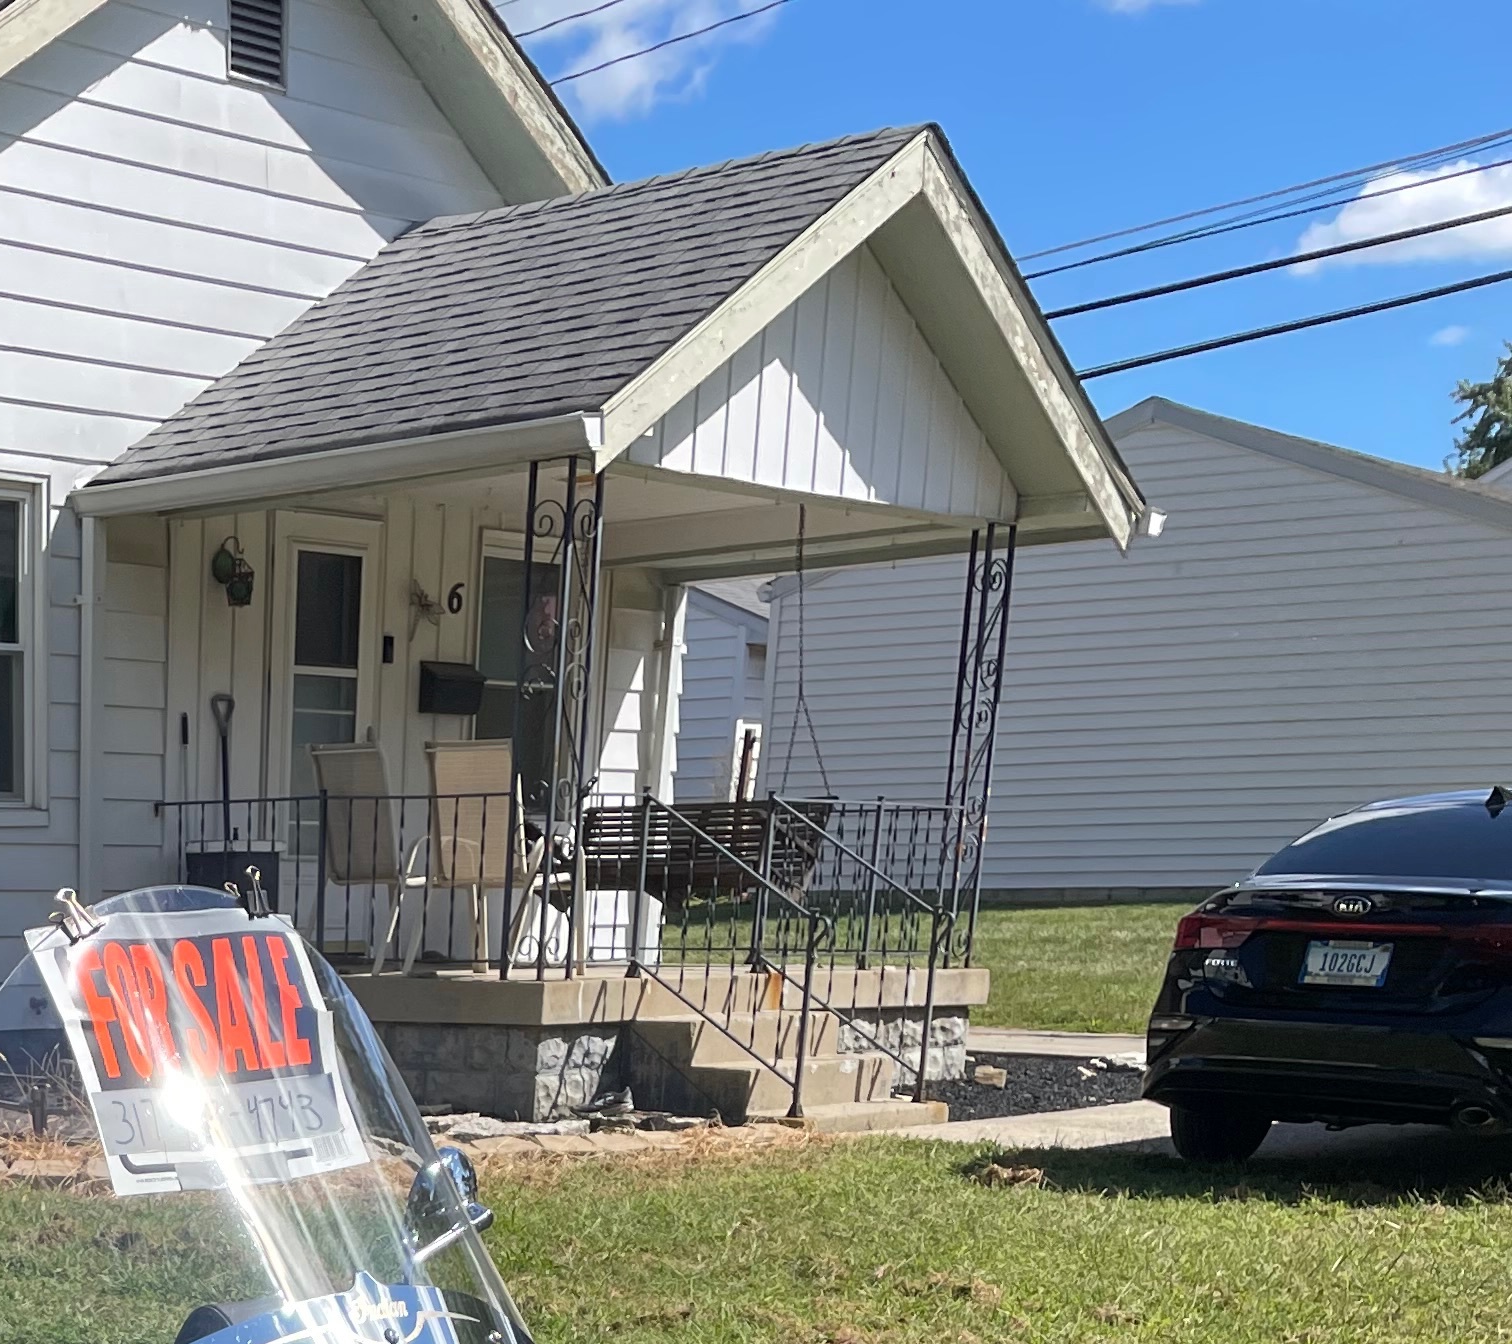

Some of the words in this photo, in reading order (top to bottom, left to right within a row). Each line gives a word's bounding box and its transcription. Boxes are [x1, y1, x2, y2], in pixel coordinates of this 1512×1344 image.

[448, 582, 465, 614] 6
[1339, 900, 1363, 912] KIA
[1318, 951, 1376, 974] 102GCJ
[75, 941, 182, 1079] FOR
[173, 935, 312, 1077] SALE
[351, 1296, 408, 1324] Indian
